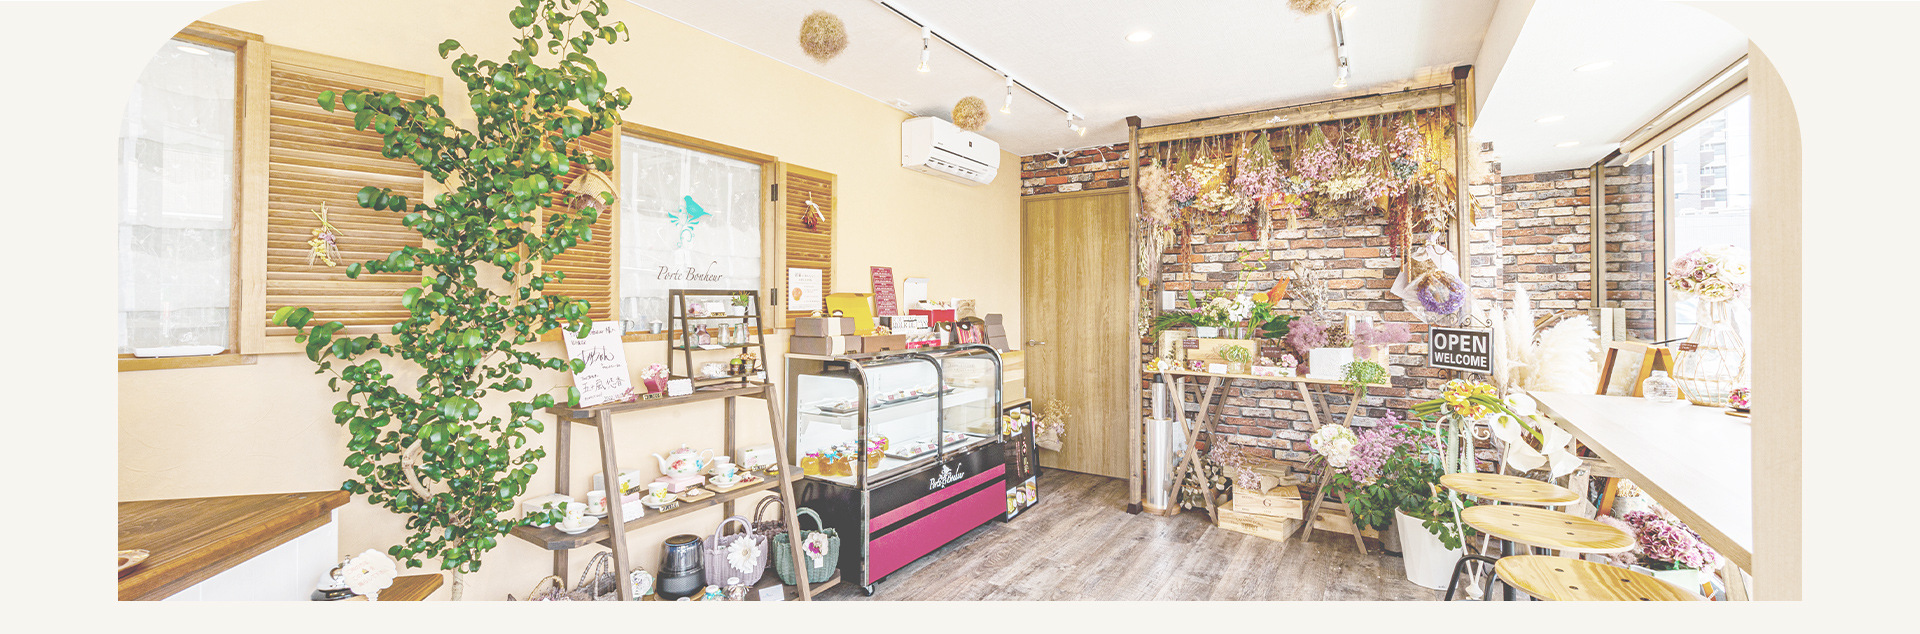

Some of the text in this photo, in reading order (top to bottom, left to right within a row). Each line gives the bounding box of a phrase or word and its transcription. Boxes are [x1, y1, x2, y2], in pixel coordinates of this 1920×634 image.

[657, 260, 723, 282] Porte Bonheur
[1434, 332, 1487, 354] OPEN
[1434, 351, 1487, 368] WELCOME
